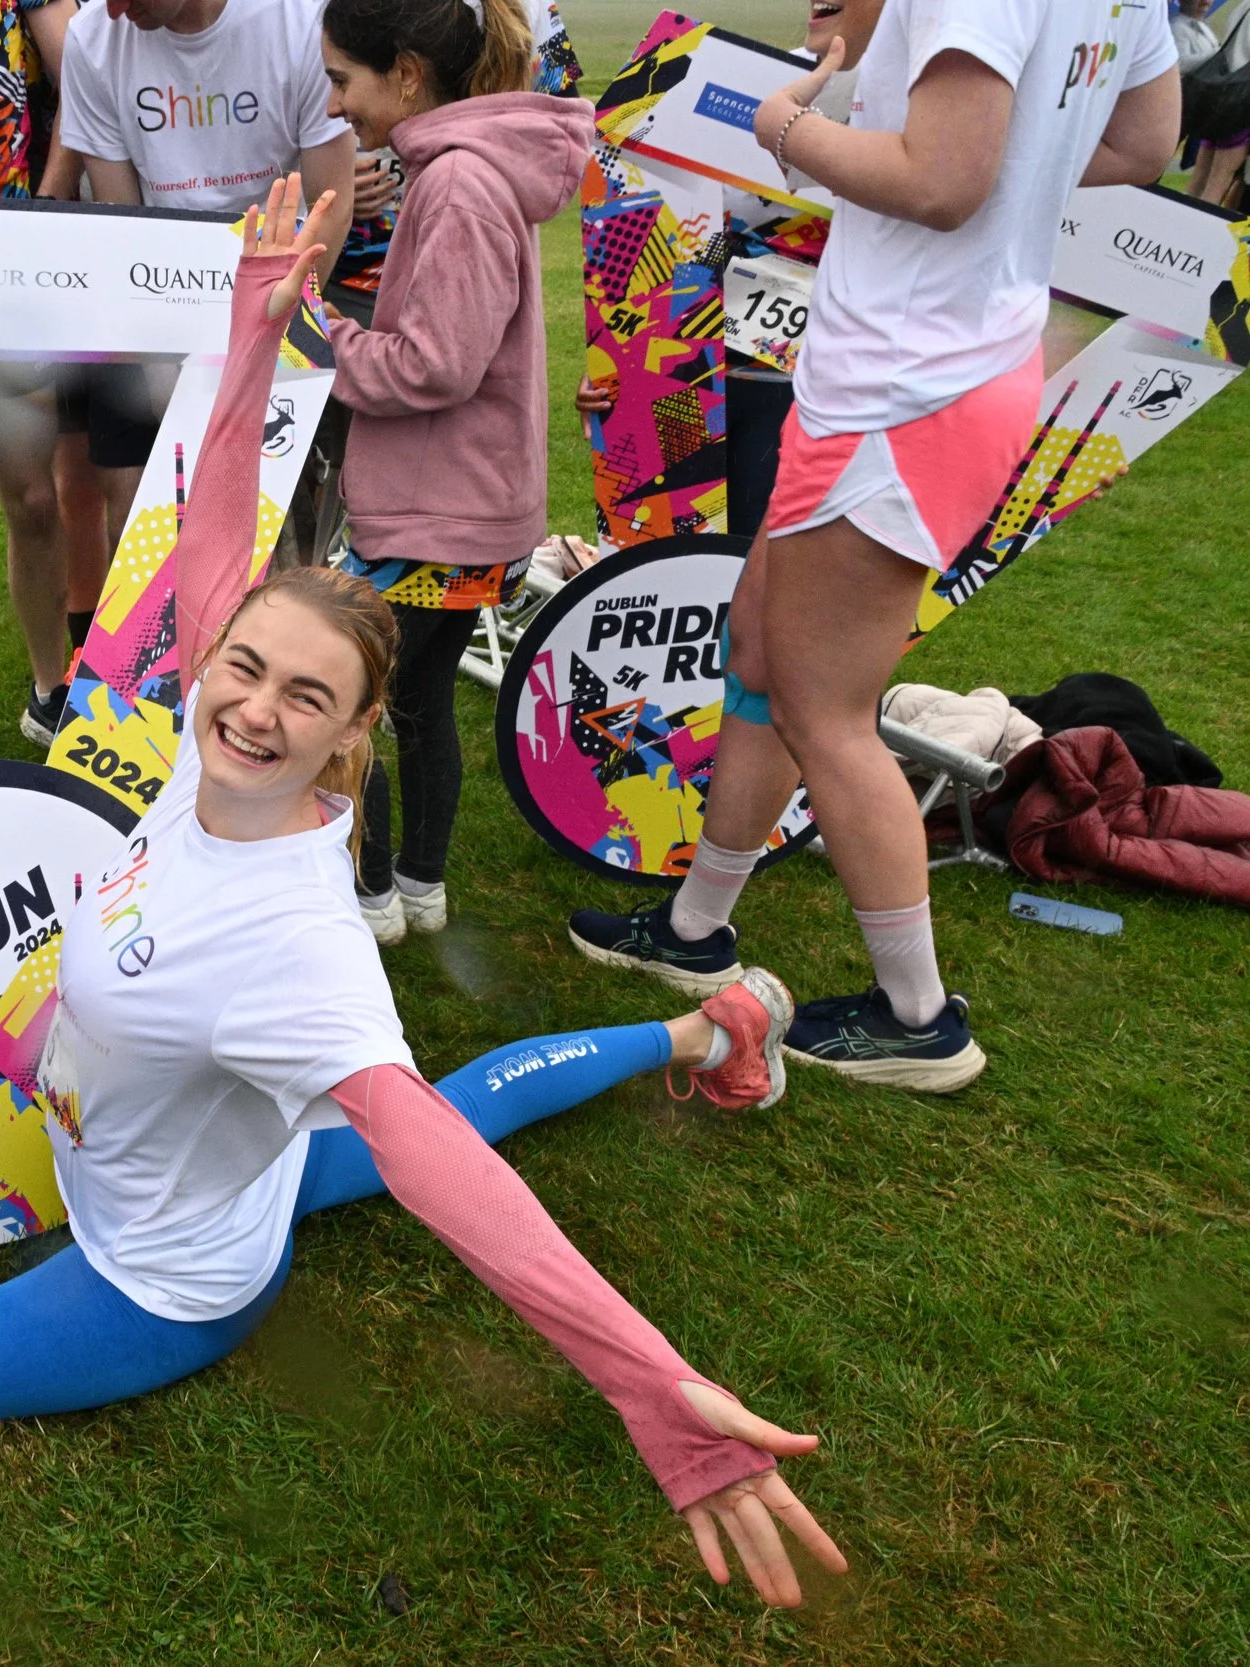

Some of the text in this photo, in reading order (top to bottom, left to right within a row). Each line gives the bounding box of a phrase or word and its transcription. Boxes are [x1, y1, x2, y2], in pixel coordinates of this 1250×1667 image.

[136, 85, 259, 132] Shine
[708, 91, 756, 114] Spencer
[204, 176, 219, 188] Be
[221, 165, 274, 187] Different
[1113, 228, 1204, 277] QUANTA
[35, 270, 89, 289] COX
[130, 262, 233, 294] QUANTA
[165, 297, 201, 305] CAPITAL
[744, 289, 809, 338] 159
[606, 308, 646, 337] 5K
[594, 594, 658, 613] DUBLIN
[612, 664, 650, 692] 5K
[661, 642, 725, 684] RU
[66, 735, 164, 806] 2024
[13, 918, 62, 962] 2024
[485, 1036, 598, 1092] LONE WOLF
